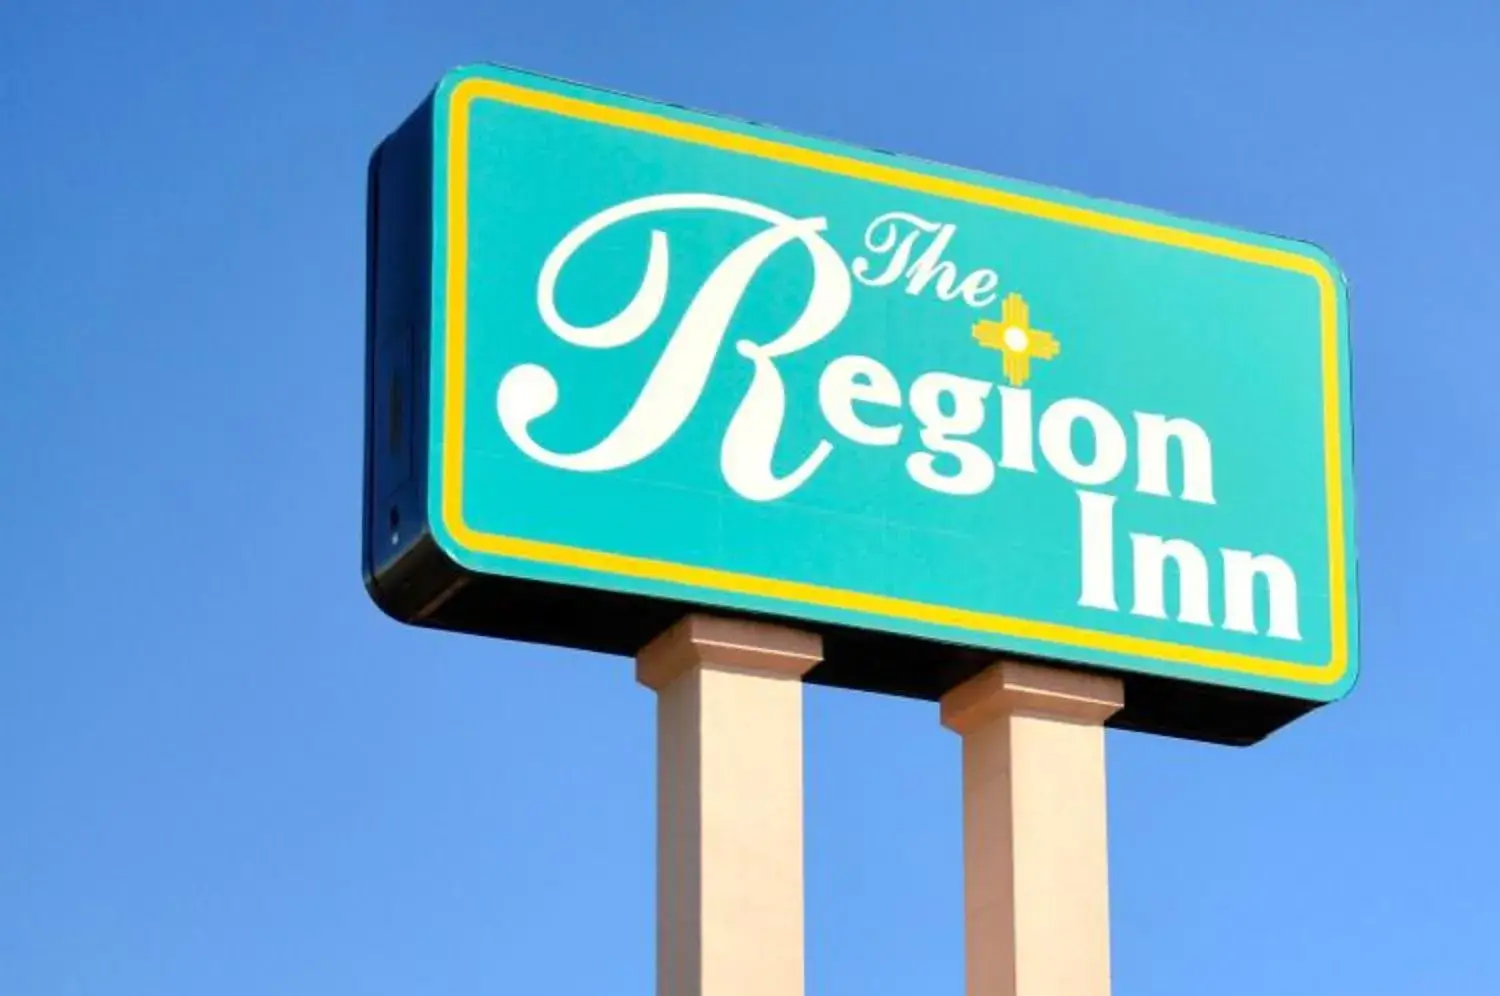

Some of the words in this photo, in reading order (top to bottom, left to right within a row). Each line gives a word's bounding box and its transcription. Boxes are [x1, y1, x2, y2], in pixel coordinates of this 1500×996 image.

[852, 211, 999, 308] The
[496, 192, 1217, 504] Region
[1077, 491, 1303, 642] Inn
